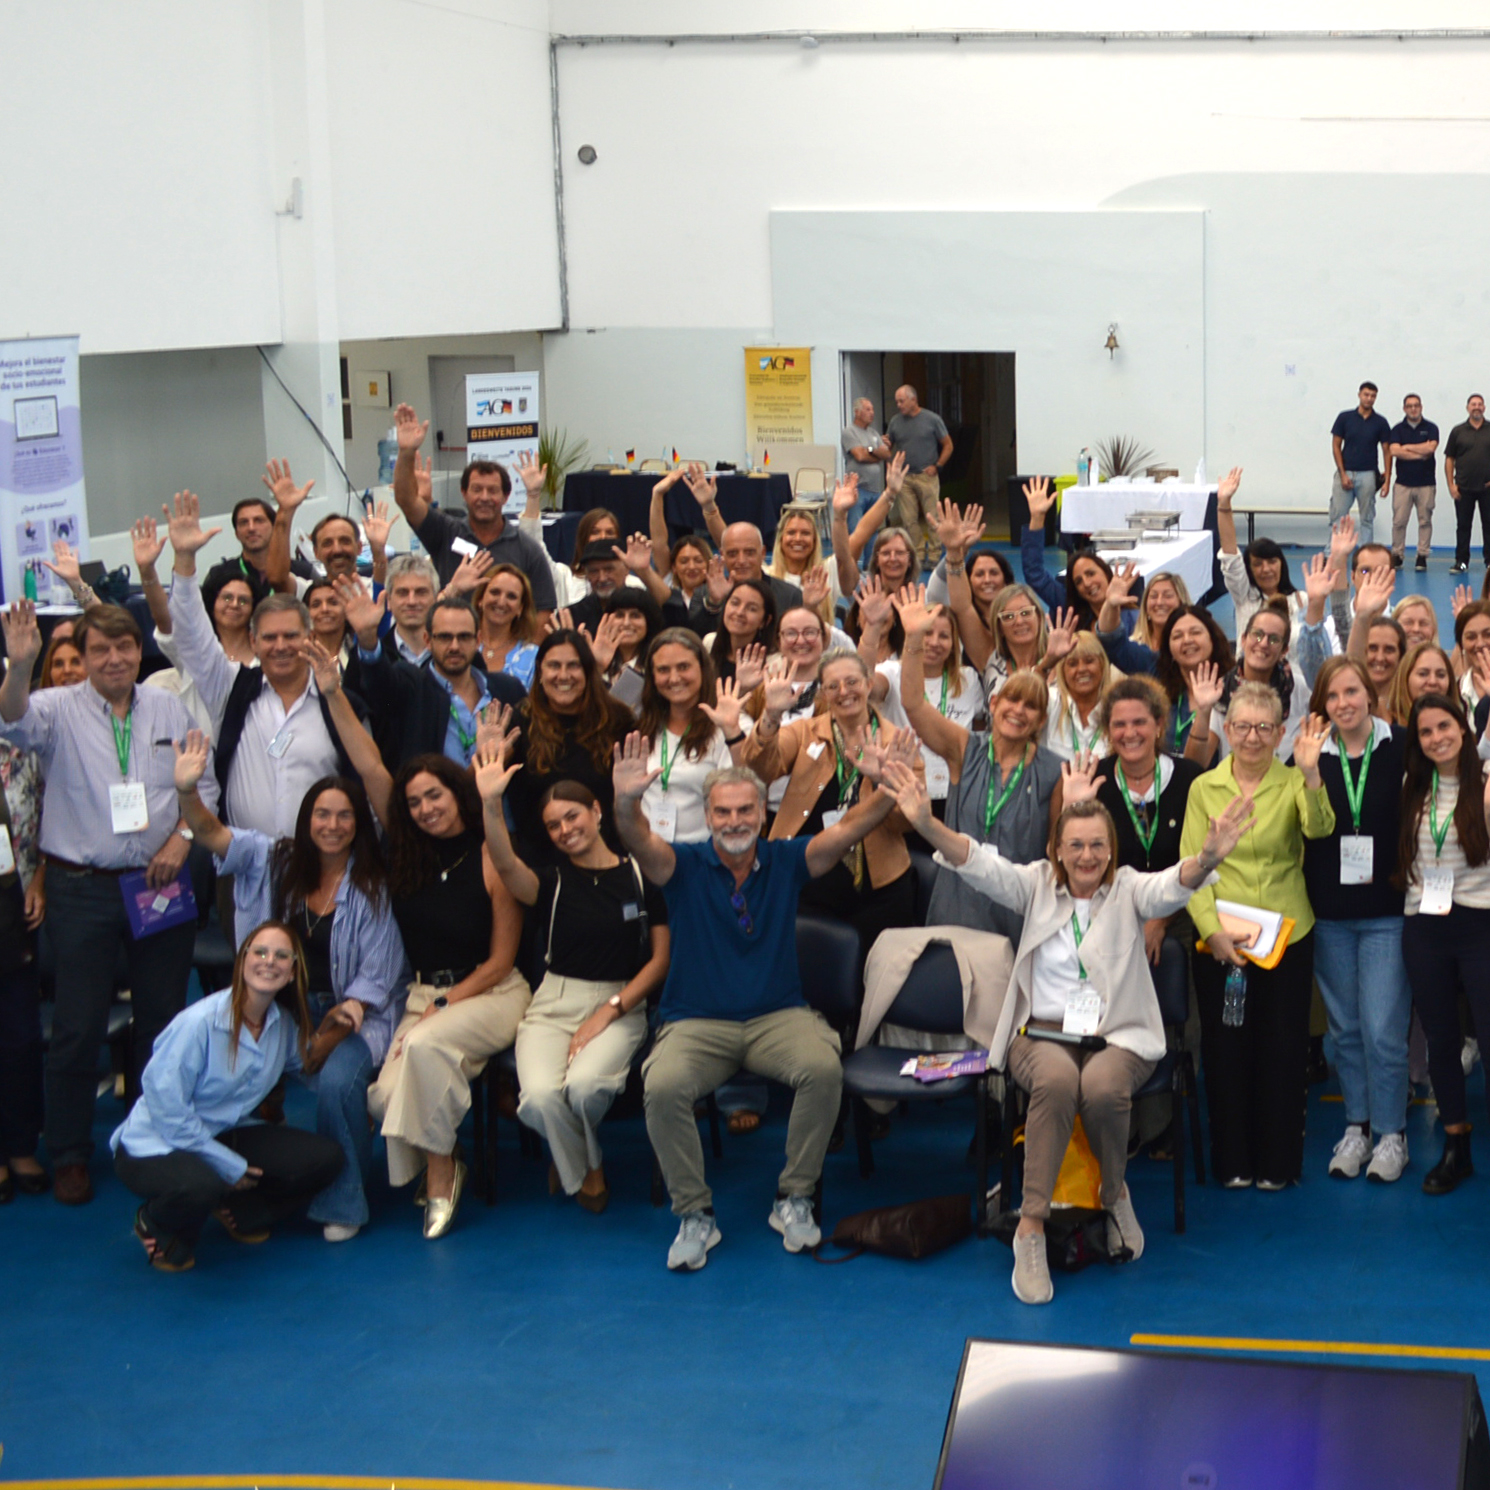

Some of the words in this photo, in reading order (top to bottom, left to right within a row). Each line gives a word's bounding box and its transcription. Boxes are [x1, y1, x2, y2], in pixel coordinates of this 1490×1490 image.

[471, 424, 533, 440] BIENVENIDOS
[757, 425, 803, 435] Bienvenidos
[756, 434, 804, 443] Willkommen
